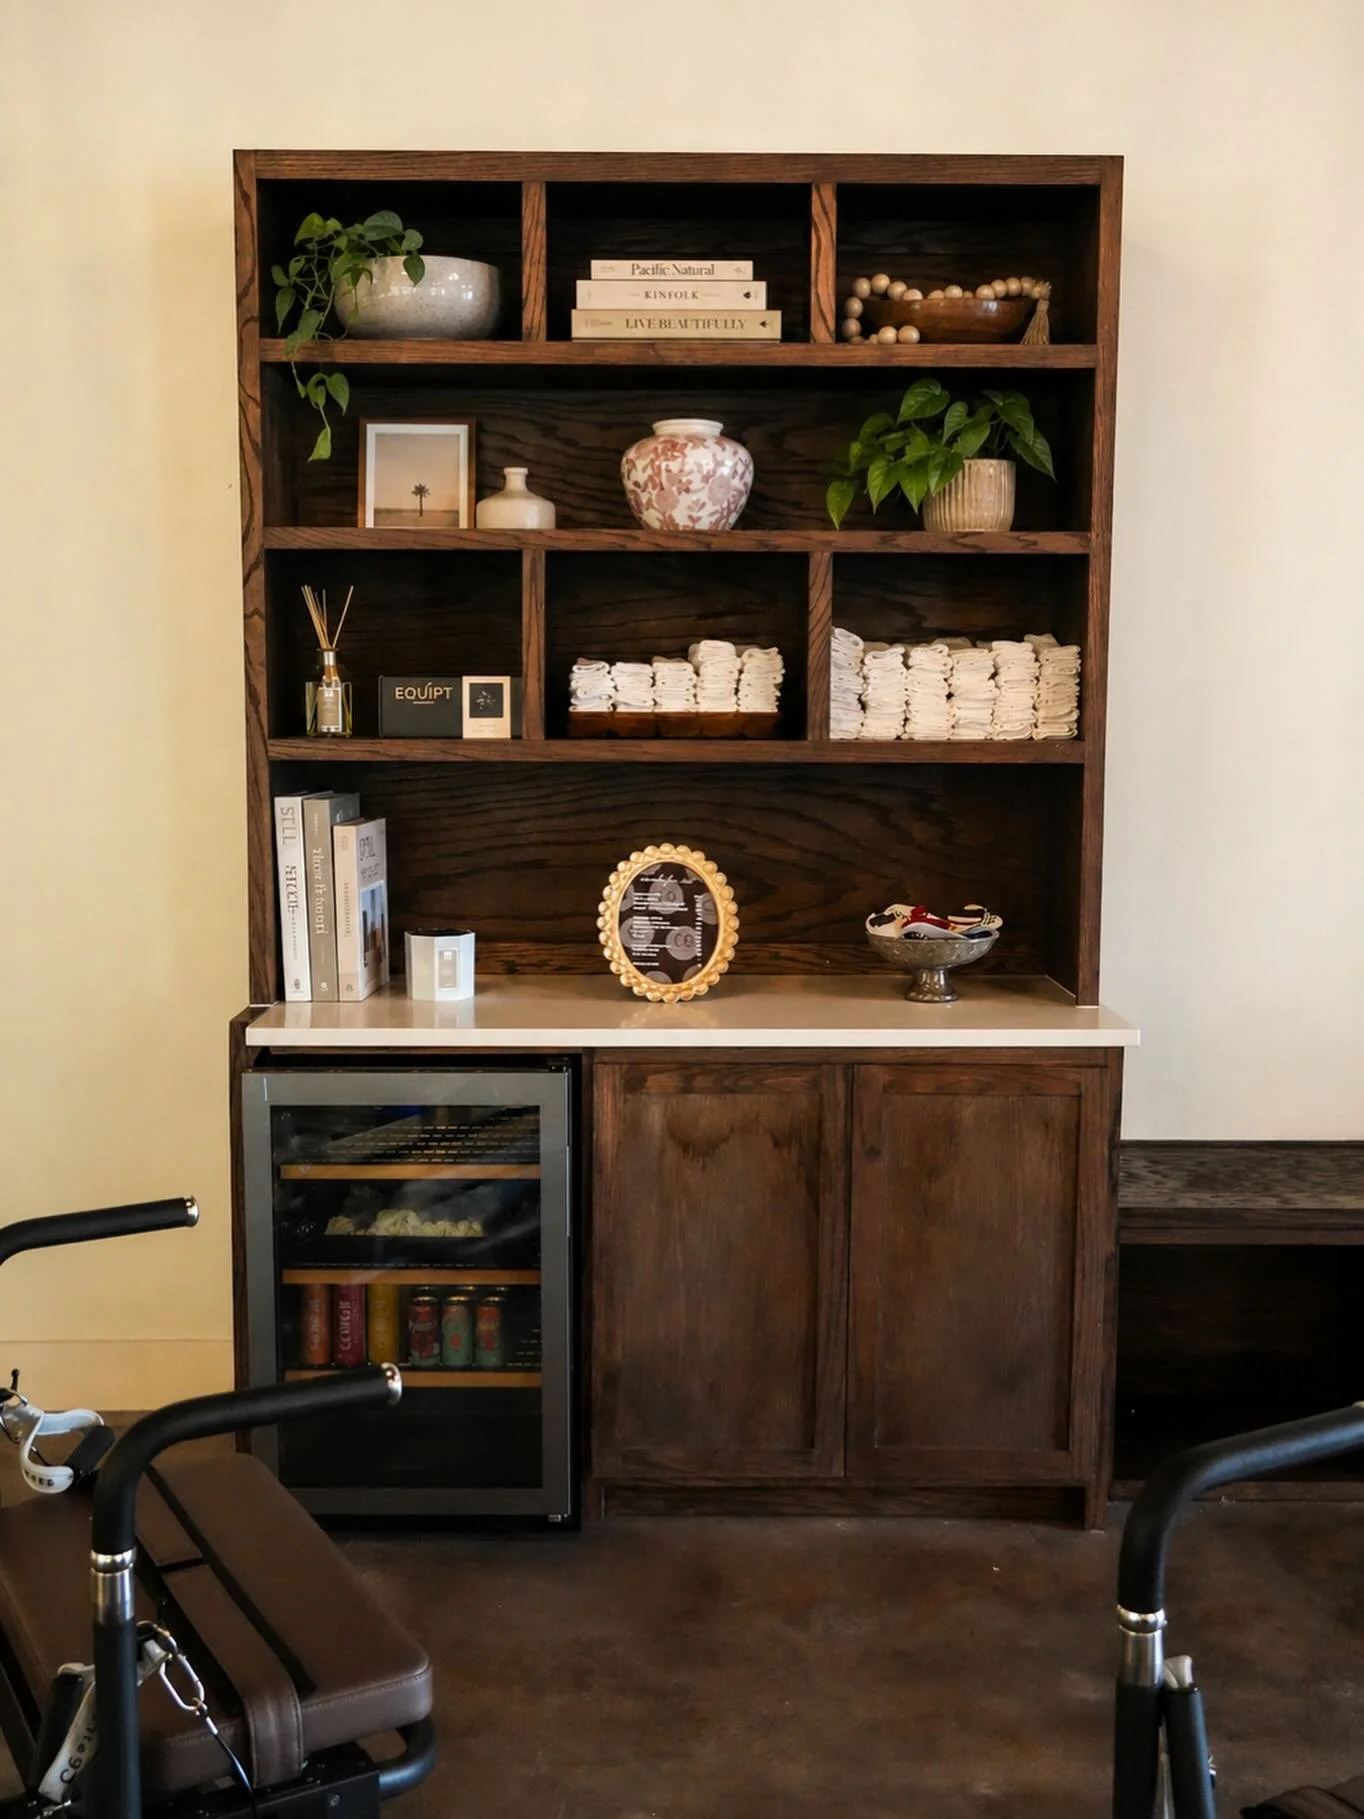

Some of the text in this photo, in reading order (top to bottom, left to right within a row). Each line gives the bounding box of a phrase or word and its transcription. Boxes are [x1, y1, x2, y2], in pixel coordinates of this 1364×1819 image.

[631, 263, 715, 276] Pacific Natural
[644, 290, 700, 300] KINFOLK
[625, 318, 657, 329] LIVE
[658, 318, 747, 330] BEAUTIFULLY
[394, 681, 453, 700] EQUIPT
